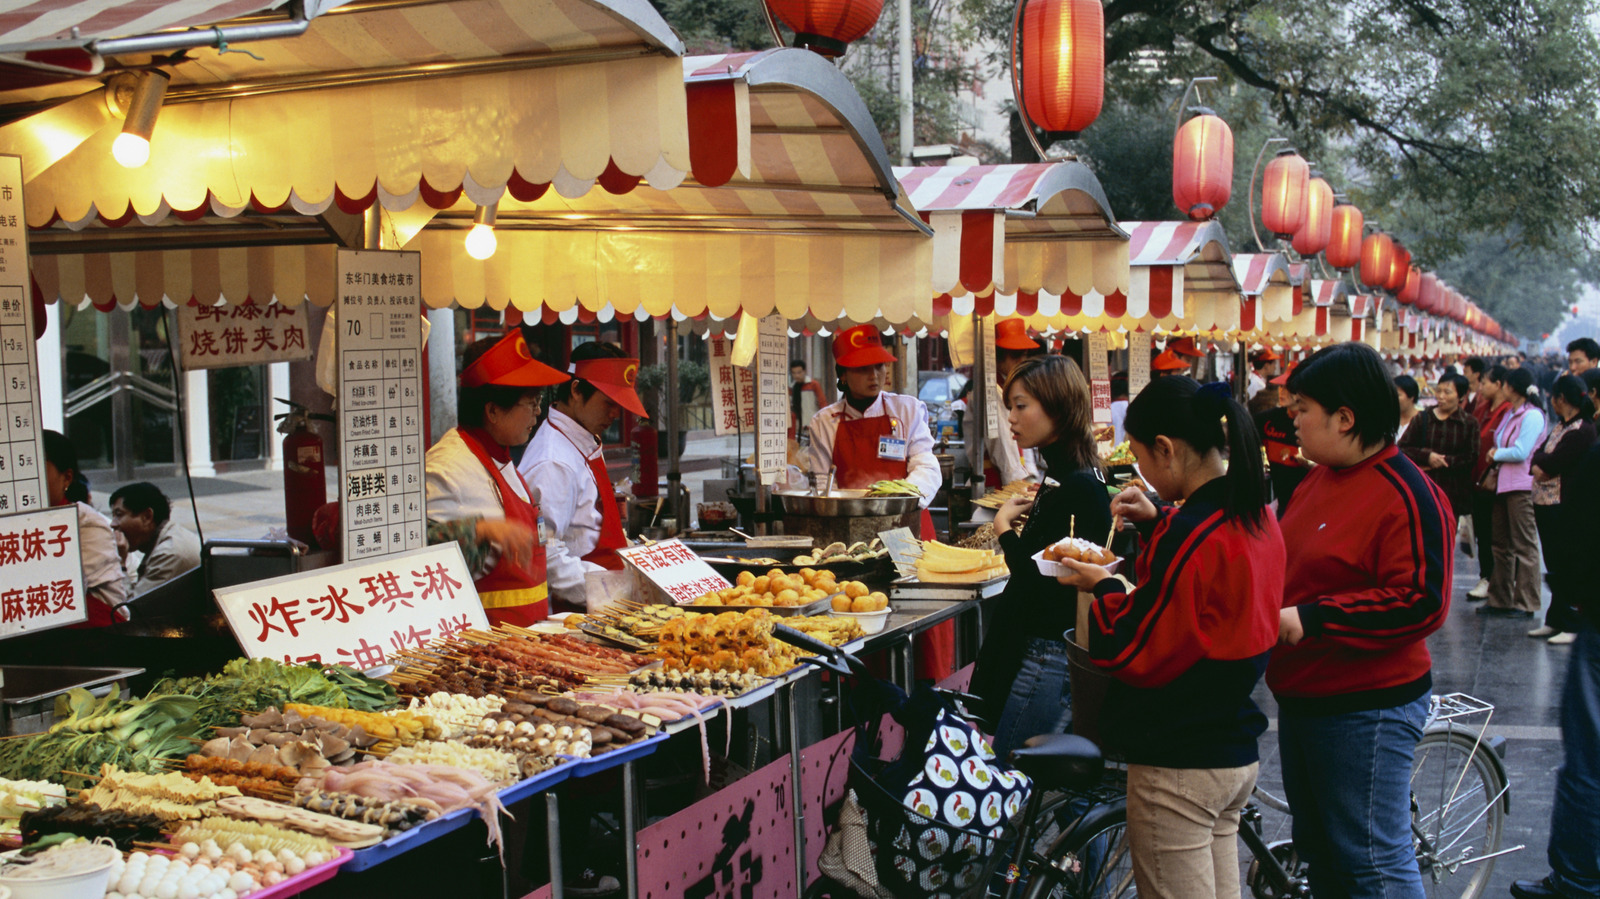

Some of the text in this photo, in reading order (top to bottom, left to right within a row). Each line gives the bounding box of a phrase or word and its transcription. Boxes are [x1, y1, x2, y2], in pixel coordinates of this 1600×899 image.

[1, 185, 13, 201] 市
[345, 272, 414, 286] 东华门美食坊夜市
[2, 299, 20, 311] 单价
[367, 295, 386, 306] 负责人
[389, 296, 415, 306] 投诉电话
[347, 319, 361, 336] 70
[3, 338, 23, 351] 1-3元
[190, 324, 305, 356] 烧饼夹肉
[348, 358, 415, 370] 食品名称 单位 单价
[12, 377, 26, 390] 5元
[404, 387, 415, 397] 8元
[719, 364, 738, 430] 麻辣烫
[739, 367, 754, 427] 担担面
[15, 415, 30, 428] 5元
[352, 413, 378, 428] 奶油炸糕
[405, 415, 415, 426] 5元
[353, 443, 416, 458] 炸藕盒 串 5元
[19, 454, 33, 467] 5元
[348, 472, 418, 497] 海鲜类 串 8元
[22, 495, 36, 507] 5元
[356, 501, 418, 517] 肉串类 串 4元
[393, 532, 401, 544] 串
[409, 531, 419, 541] 5元
[0, 524, 72, 567] 辣妹子
[626, 541, 696, 572] 有滋有味
[1, 579, 76, 623] 麻辣烫
[248, 562, 463, 642] 炸冰琪淋
[774, 783, 785, 812] 70
